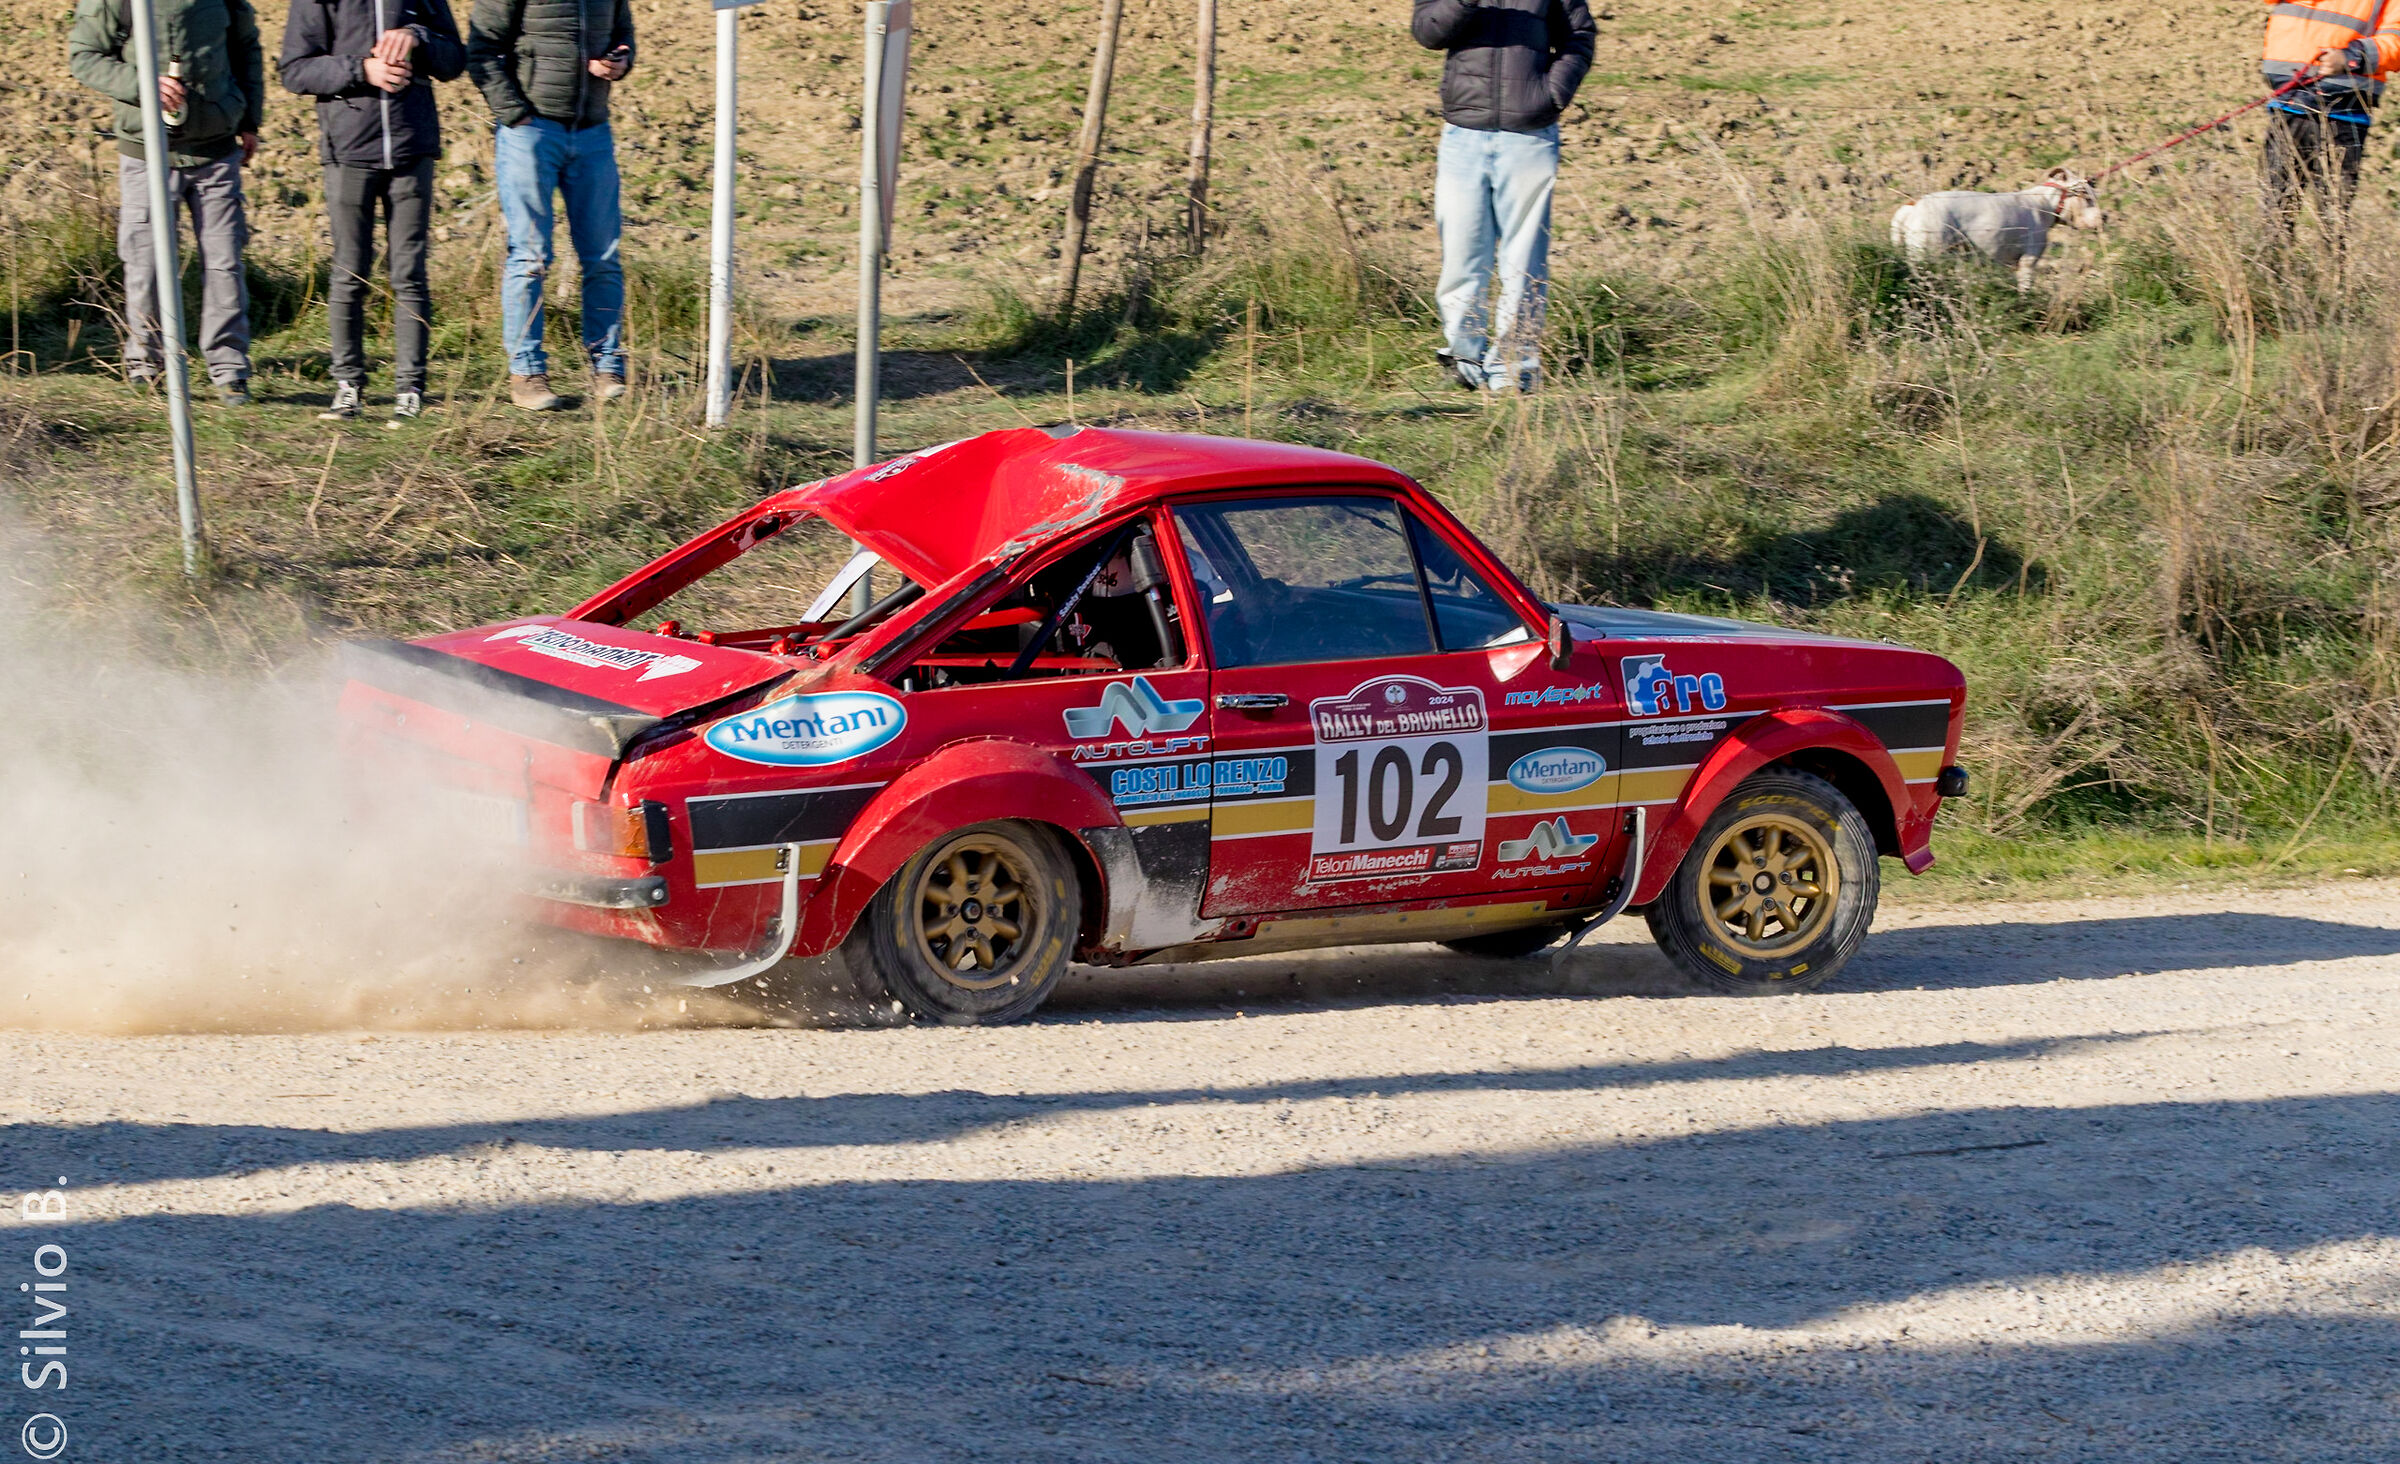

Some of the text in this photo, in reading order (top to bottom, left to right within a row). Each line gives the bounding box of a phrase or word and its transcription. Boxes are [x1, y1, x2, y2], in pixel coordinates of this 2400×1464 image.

[1428, 695, 1454, 705] 2024
[728, 707, 887, 743] Mentani
[1320, 703, 1479, 739] RALLY DEL BRUNELLO
[781, 737, 844, 750] DETERGENTI
[1071, 736, 1210, 760] AUTOLIFT
[1111, 757, 1288, 796] COSTI LORENZO
[1520, 758, 1595, 779] Mentani
[1335, 741, 1463, 845] 102
[1491, 862, 1591, 879] AUTOLIFT
